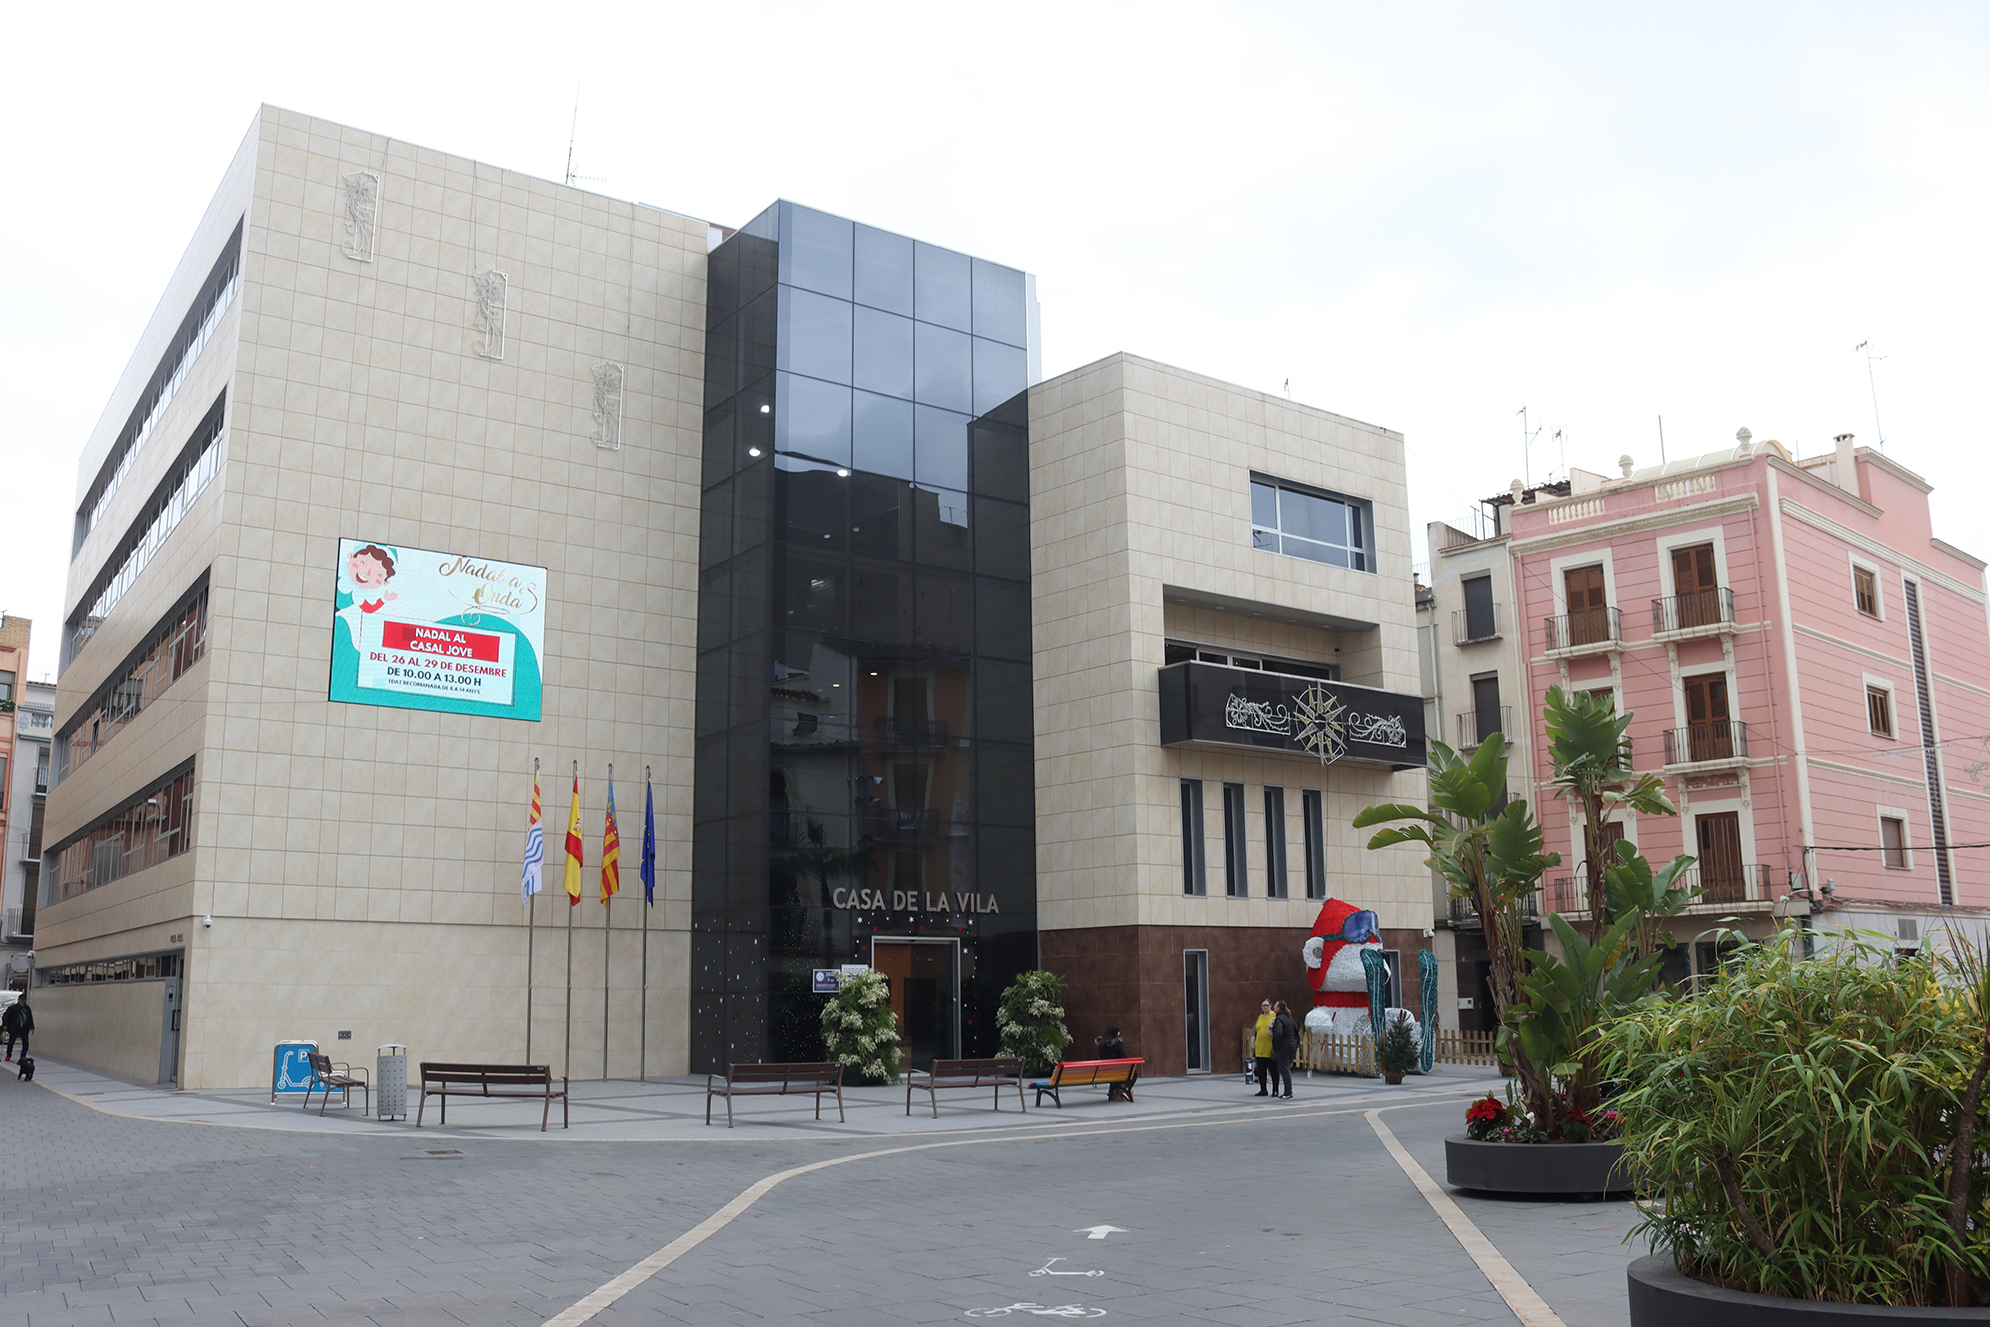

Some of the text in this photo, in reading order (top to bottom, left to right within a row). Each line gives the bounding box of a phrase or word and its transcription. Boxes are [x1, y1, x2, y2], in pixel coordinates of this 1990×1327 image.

[439, 557, 521, 588] Nadal a
[472, 582, 523, 608] Onda
[415, 628, 467, 644] NADAL AL
[410, 640, 473, 657] CASAL JOVE
[370, 652, 507, 677] DEL 26 AL 29 DE DESEMBRE
[387, 667, 481, 686] DE 10.00 A 13.00 H
[832, 887, 1000, 914] CASA DE LA VILA
[300, 1051, 308, 1061] P
